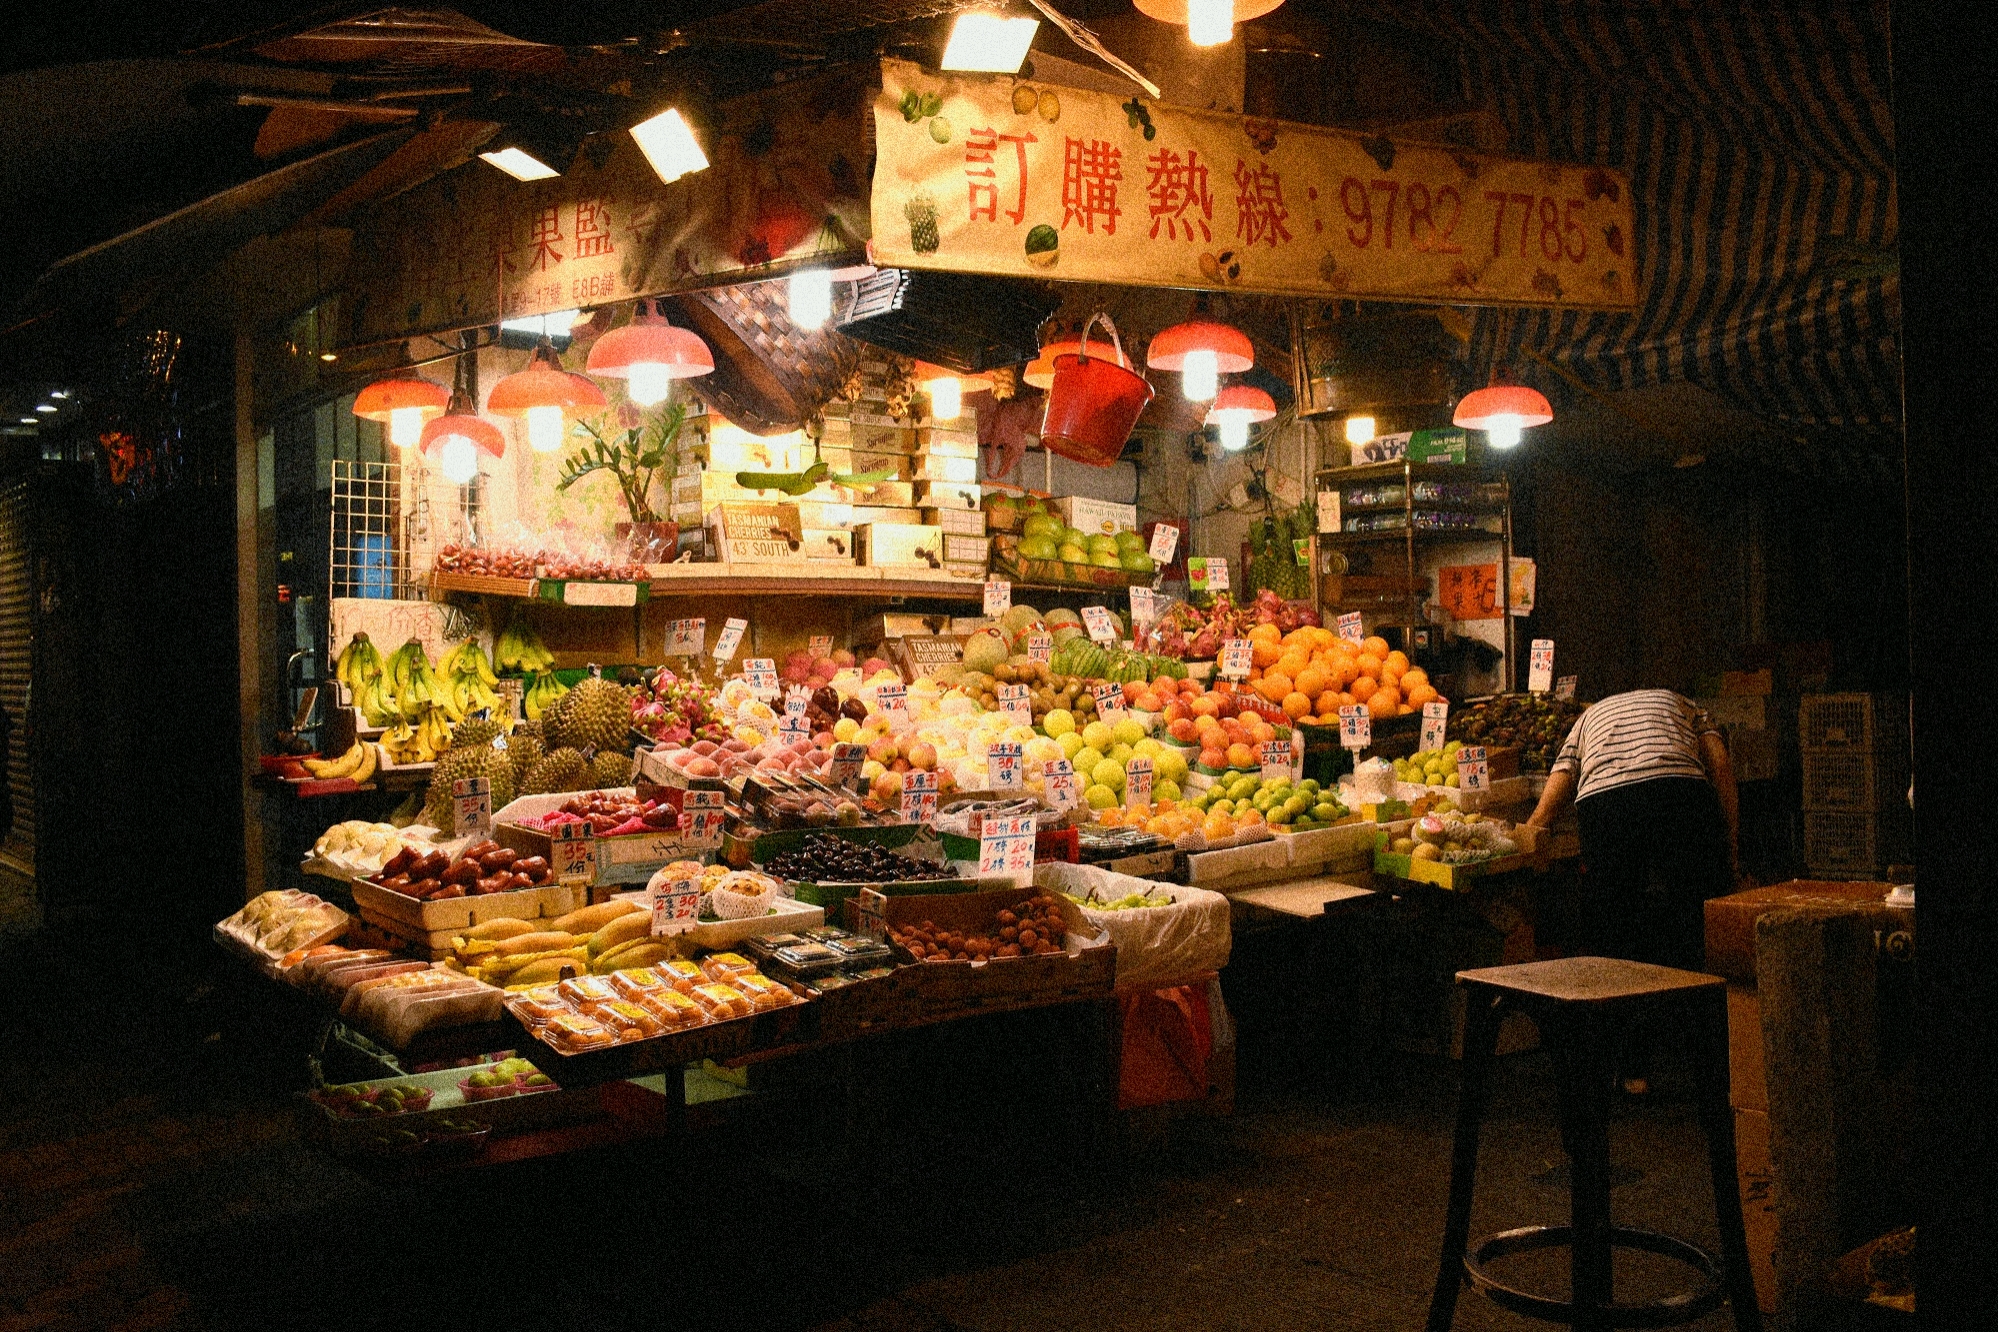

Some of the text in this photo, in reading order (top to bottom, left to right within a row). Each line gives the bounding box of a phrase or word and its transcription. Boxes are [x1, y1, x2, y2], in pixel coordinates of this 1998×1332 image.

[1339, 176, 1464, 255] 9782
[1485, 190, 1588, 264] 7785
[726, 513, 780, 529] TASMANIAN
[728, 526, 772, 540] CHERRIES
[752, 542, 790, 558] SOUTH
[912, 641, 964, 653] TASMANIAN
[915, 651, 958, 663] CHERRIES
